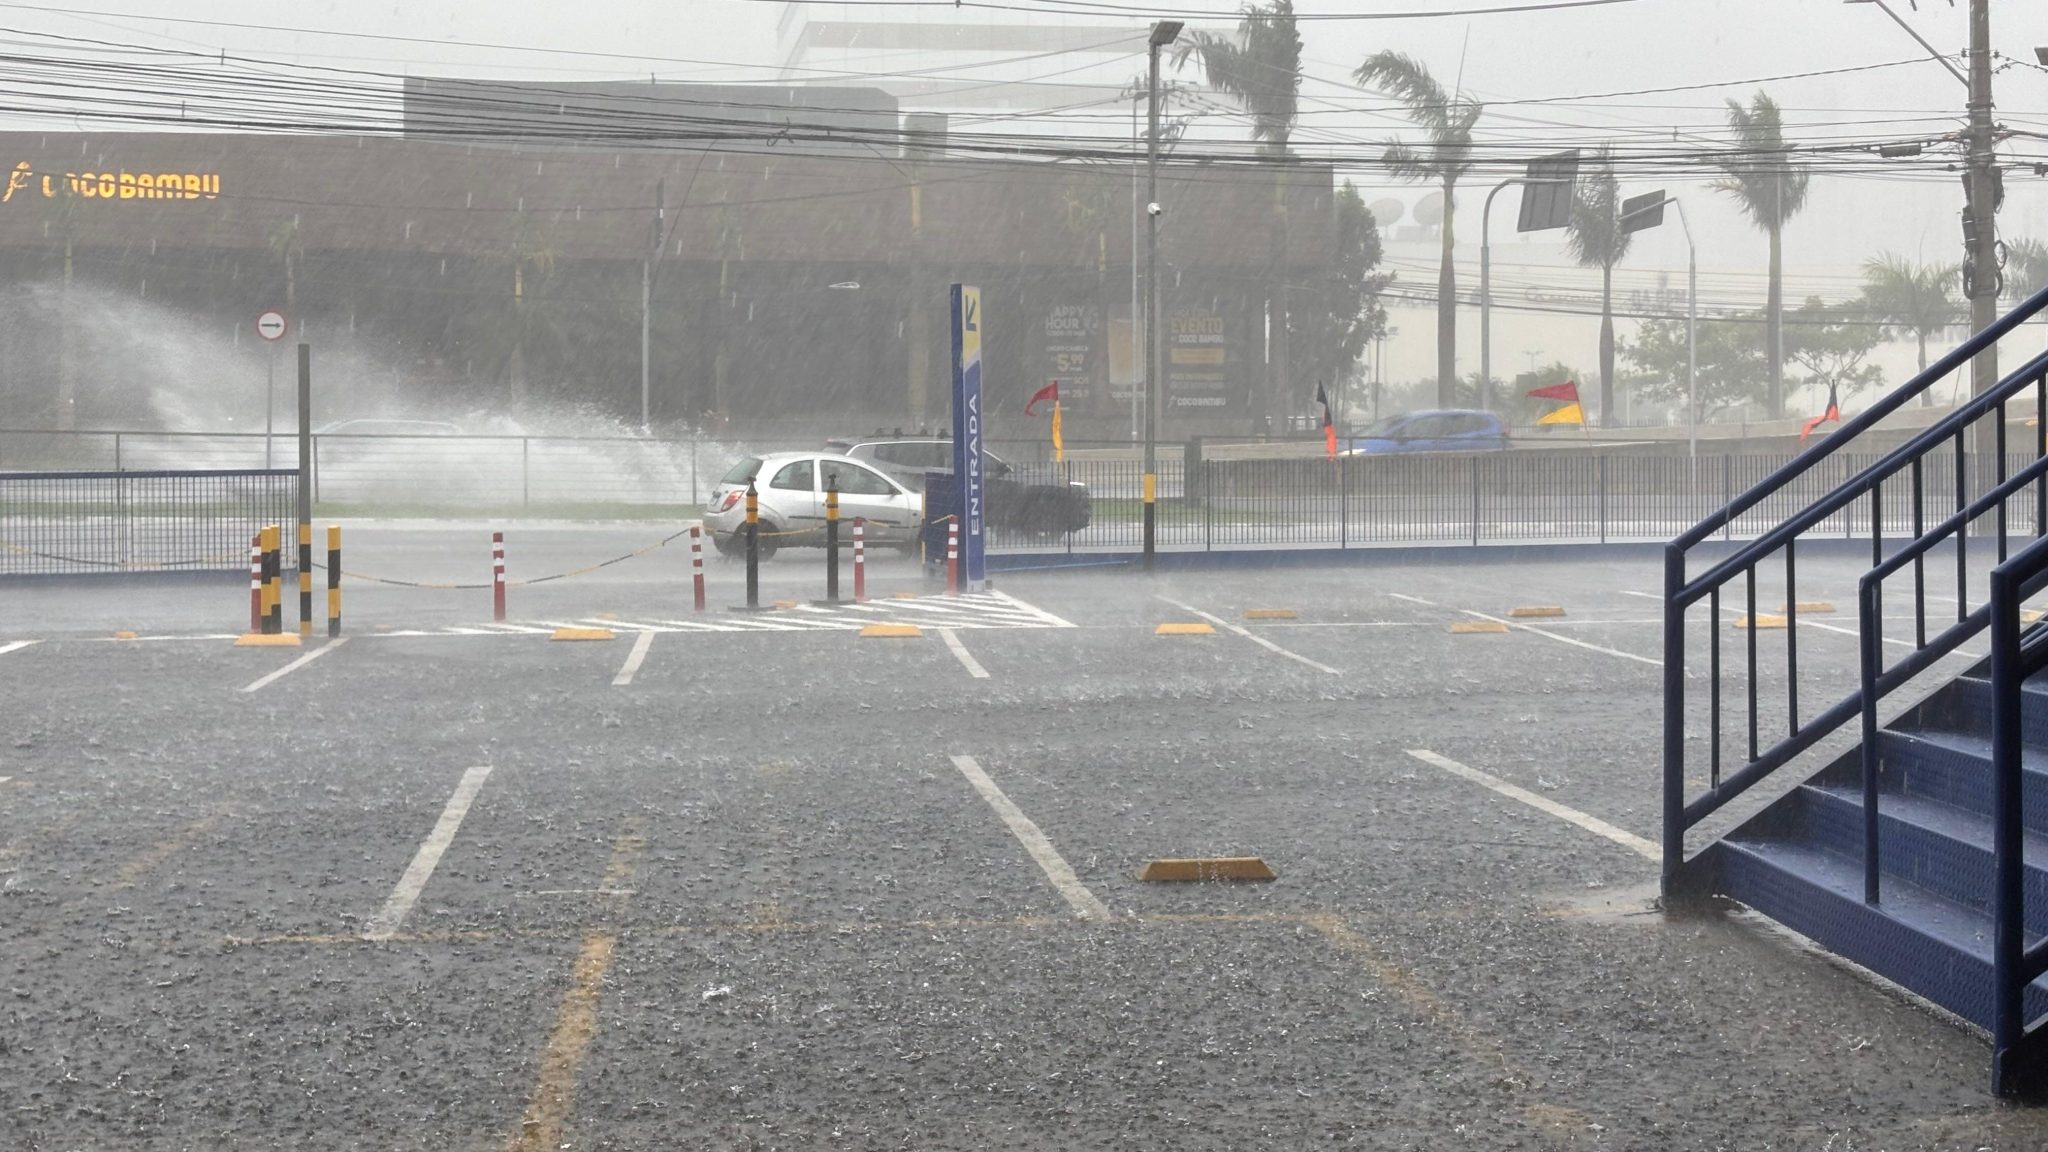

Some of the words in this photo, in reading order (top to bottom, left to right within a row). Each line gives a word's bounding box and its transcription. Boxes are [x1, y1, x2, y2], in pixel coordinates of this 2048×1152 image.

[1045, 314, 1079, 329] HOUR
[1170, 317, 1224, 333] EVENTO
[969, 394, 980, 536] ENTRADA
